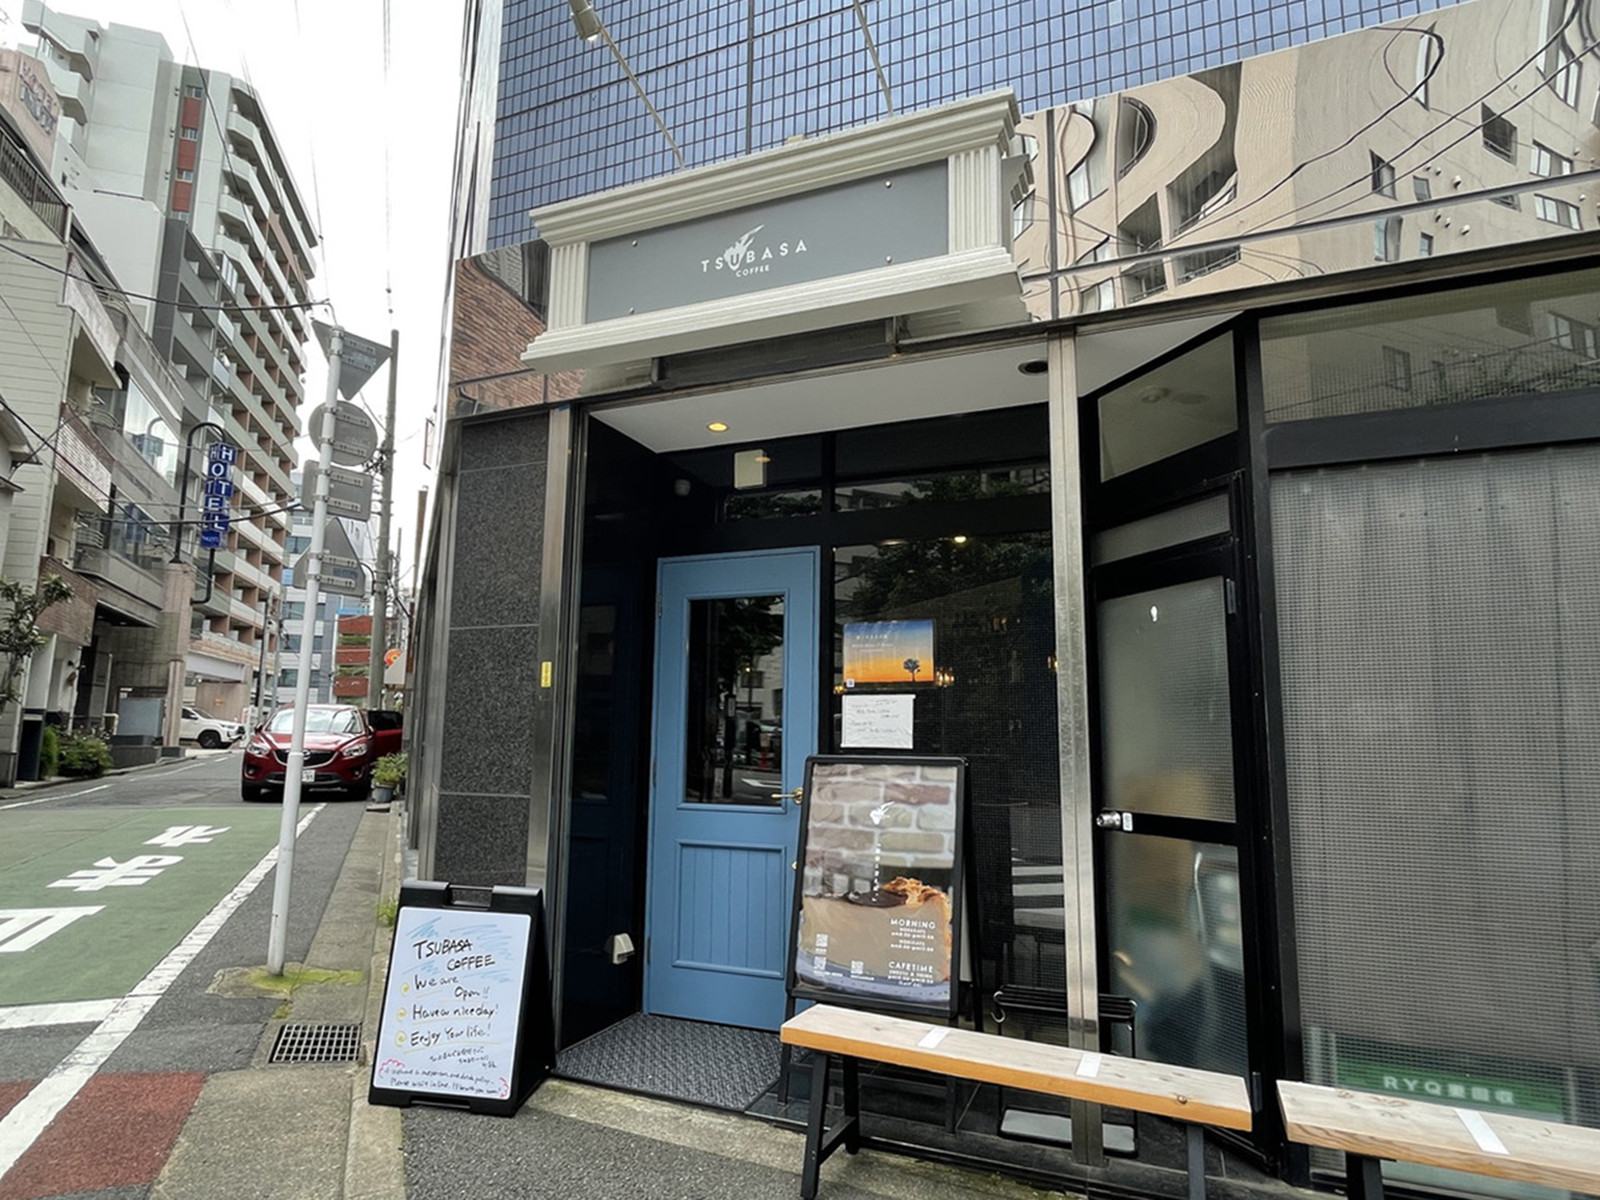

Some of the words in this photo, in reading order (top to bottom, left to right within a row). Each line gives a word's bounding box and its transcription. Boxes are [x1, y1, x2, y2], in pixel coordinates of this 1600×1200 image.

[701, 239, 807, 272] TSUBASA
[735, 264, 770, 278] COFFEE
[208, 447, 232, 530] HOTEL
[890, 918, 936, 930] MORNING
[413, 939, 473, 960] TSUBASA
[447, 954, 495, 971] COFFEE
[414, 974, 437, 990] We
[440, 976, 459, 985] are
[411, 1031, 440, 1047] Enjoy
